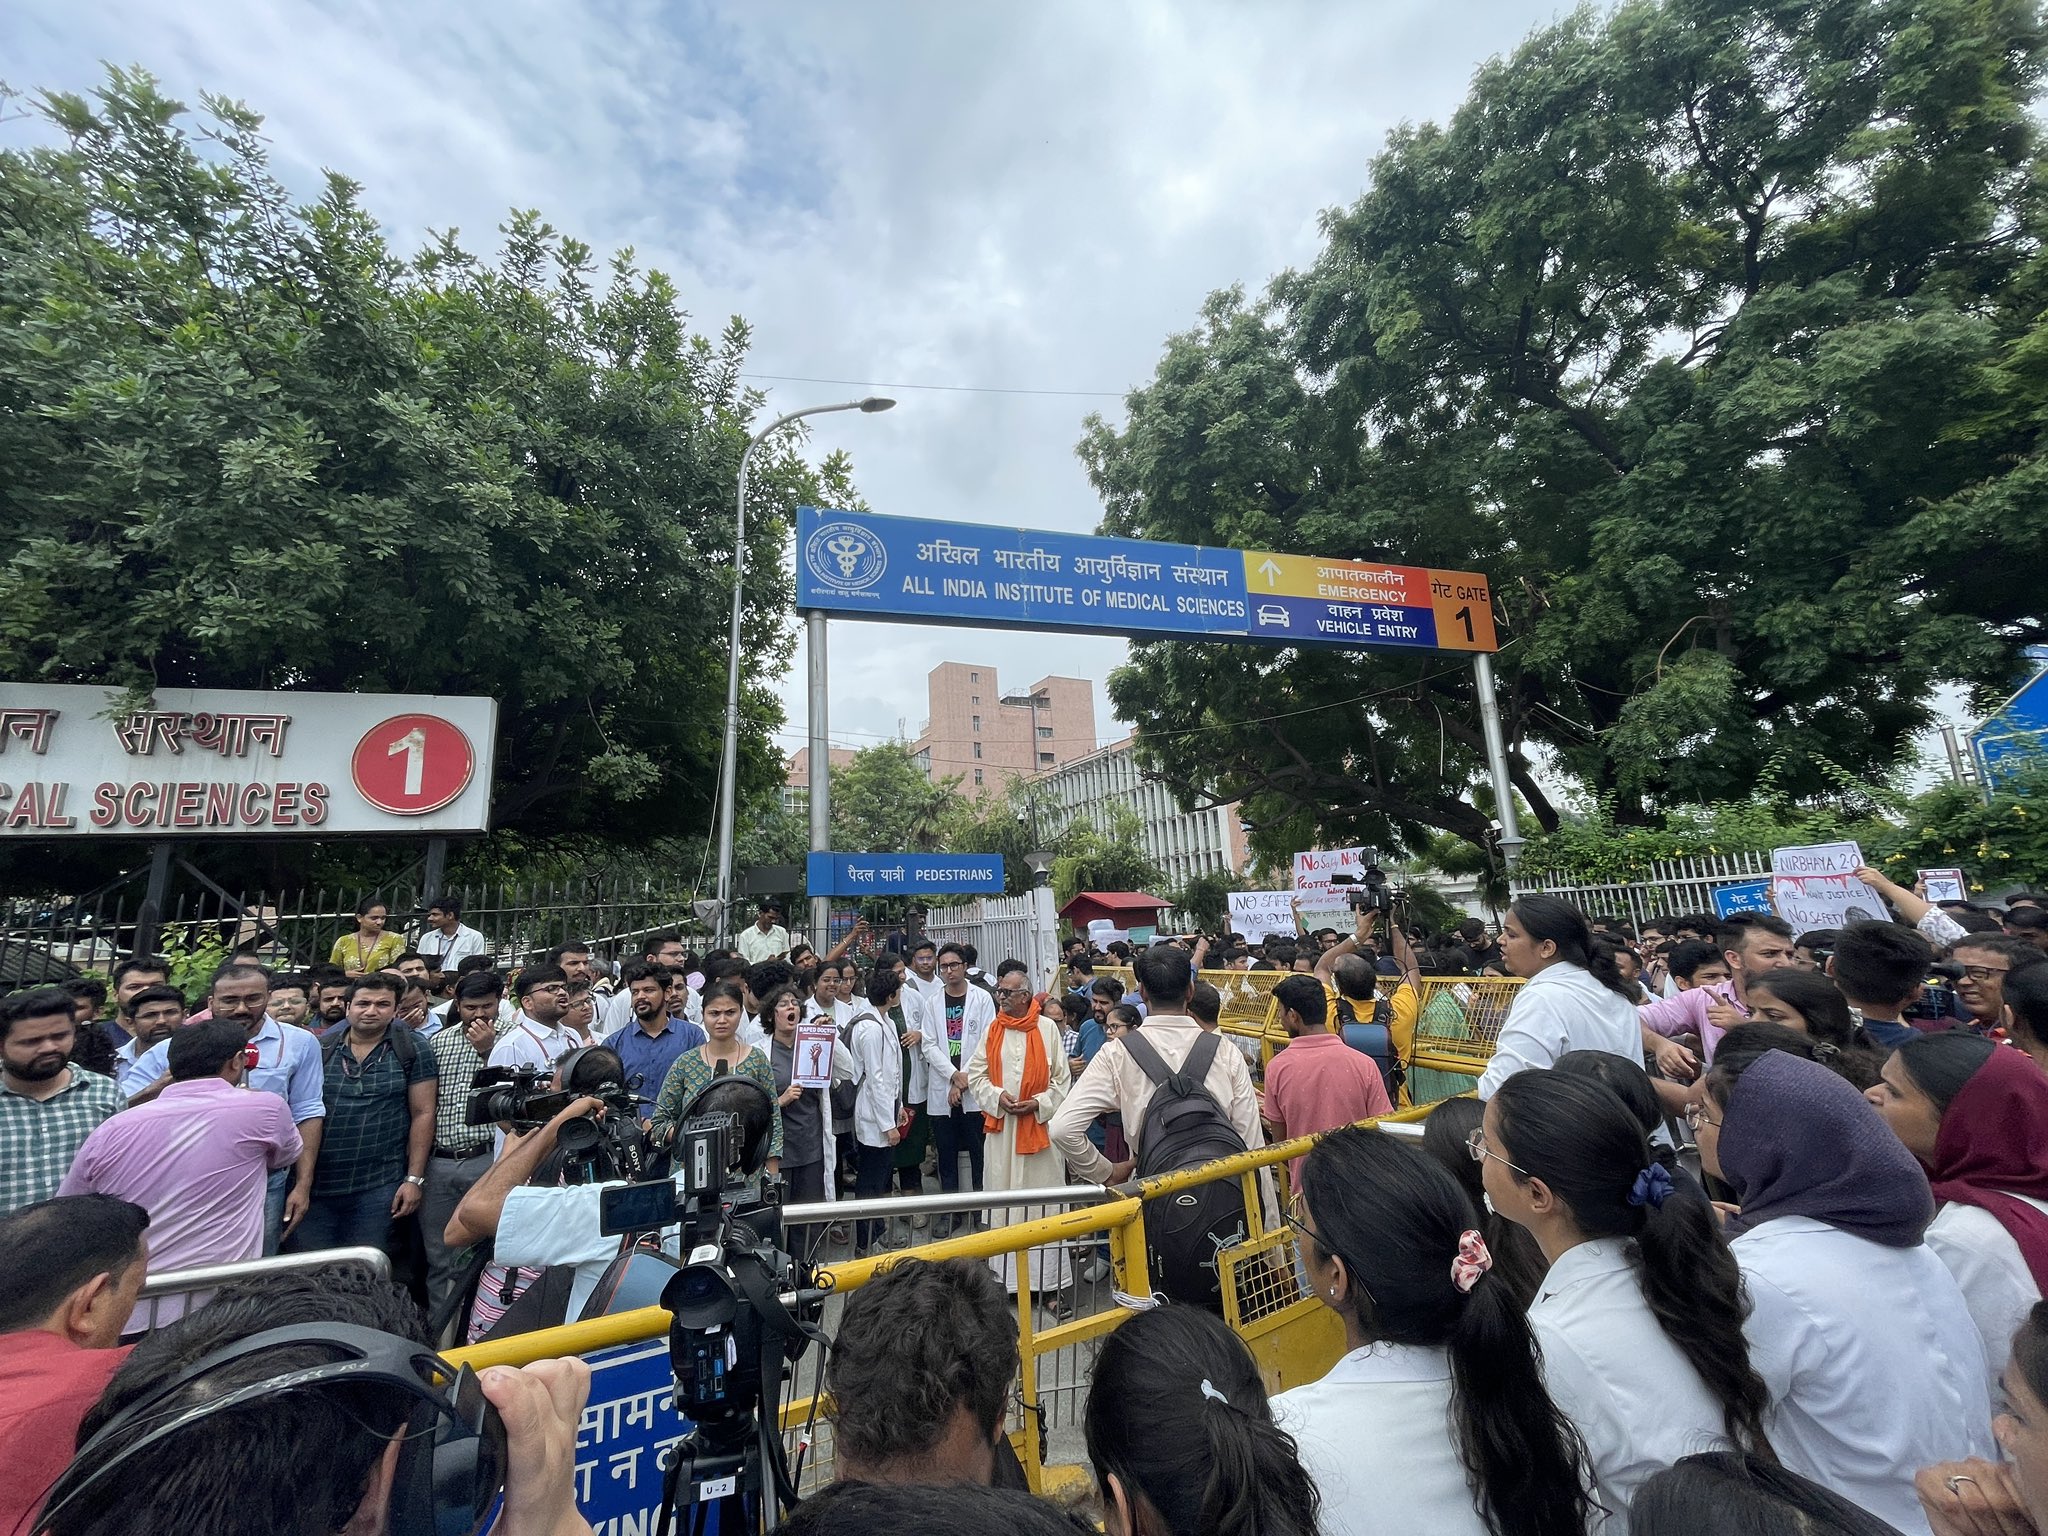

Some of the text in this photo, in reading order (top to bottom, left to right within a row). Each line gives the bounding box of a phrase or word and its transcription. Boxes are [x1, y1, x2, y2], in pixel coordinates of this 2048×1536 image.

[916, 539, 1229, 587] अखिल भारतीय आयुर्विज्ञान संस्थान
[1316, 566, 1405, 586] आपातकालीन
[902, 575, 1246, 618] ALL INDIA INSTITUTE OF MEDICAL SCIENCES
[1318, 583, 1407, 603] EMERGENCY
[1430, 578, 1488, 602] गेट GATE
[1327, 604, 1404, 622] वाहन प्रवेश
[1316, 619, 1418, 639] VEHICLE ENTRY
[1455, 606, 1475, 643] 1
[387, 727, 428, 796] 1
[89, 781, 330, 828] SCIENCES
[1301, 854, 1320, 870] No
[1780, 855, 1836, 872] NIRBHAYA
[847, 864, 993, 882] पैदल यात्री PEDESTRIANS
[1235, 896, 1257, 911] NO
[1730, 893, 1749, 905] गेट
[1245, 913, 1264, 926] NO
[1788, 904, 1808, 924] NO
[628, 1144, 642, 1172] SONY
